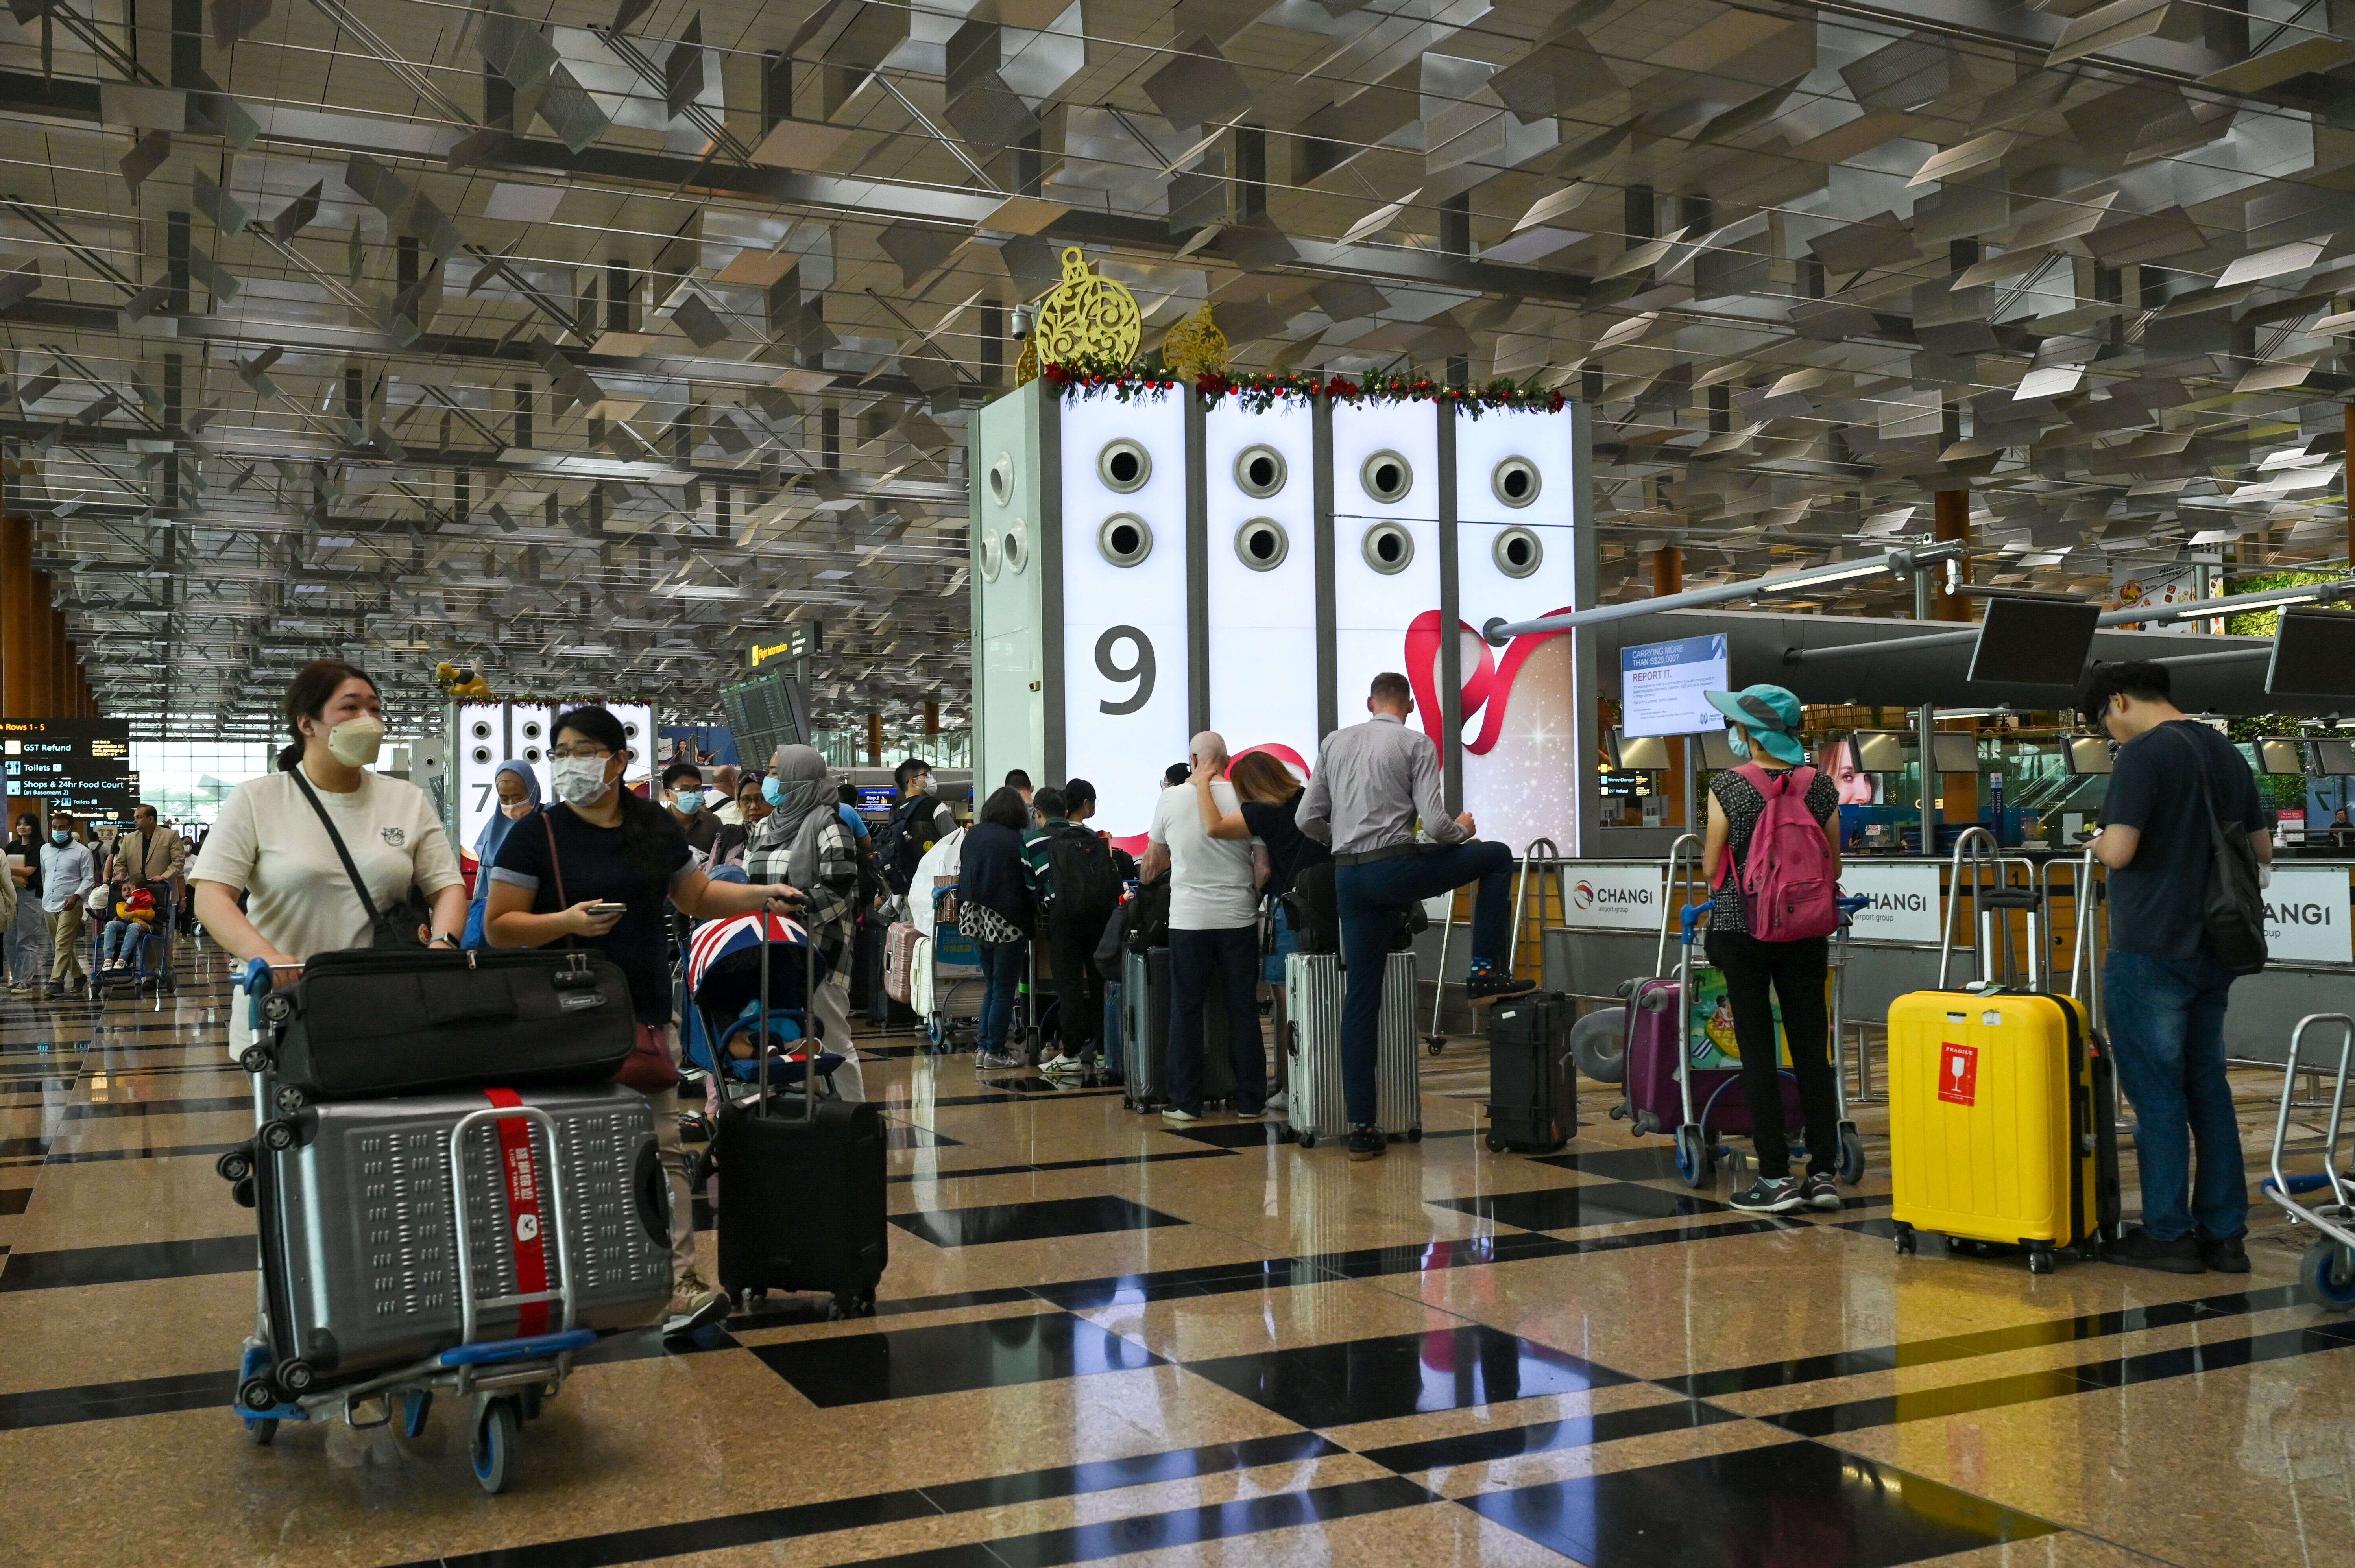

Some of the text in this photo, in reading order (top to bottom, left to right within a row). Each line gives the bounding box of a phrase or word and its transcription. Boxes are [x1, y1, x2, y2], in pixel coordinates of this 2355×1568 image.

[759, 647, 768, 660] Flight
[768, 642, 787, 656] Information
[1632, 645, 1684, 659] CARRYING MORE
[1633, 657, 1649, 667] THAN
[1095, 625, 1156, 715] 9
[1633, 670, 1662, 682] REPORT
[472, 783, 492, 812] 7
[1597, 888, 1653, 904] CHANGI
[1854, 913, 1894, 923] airport group
[2264, 903, 2330, 925] ANGI
[2264, 930, 2281, 939] oup
[1946, 1046, 1973, 1056] FRAGILE
